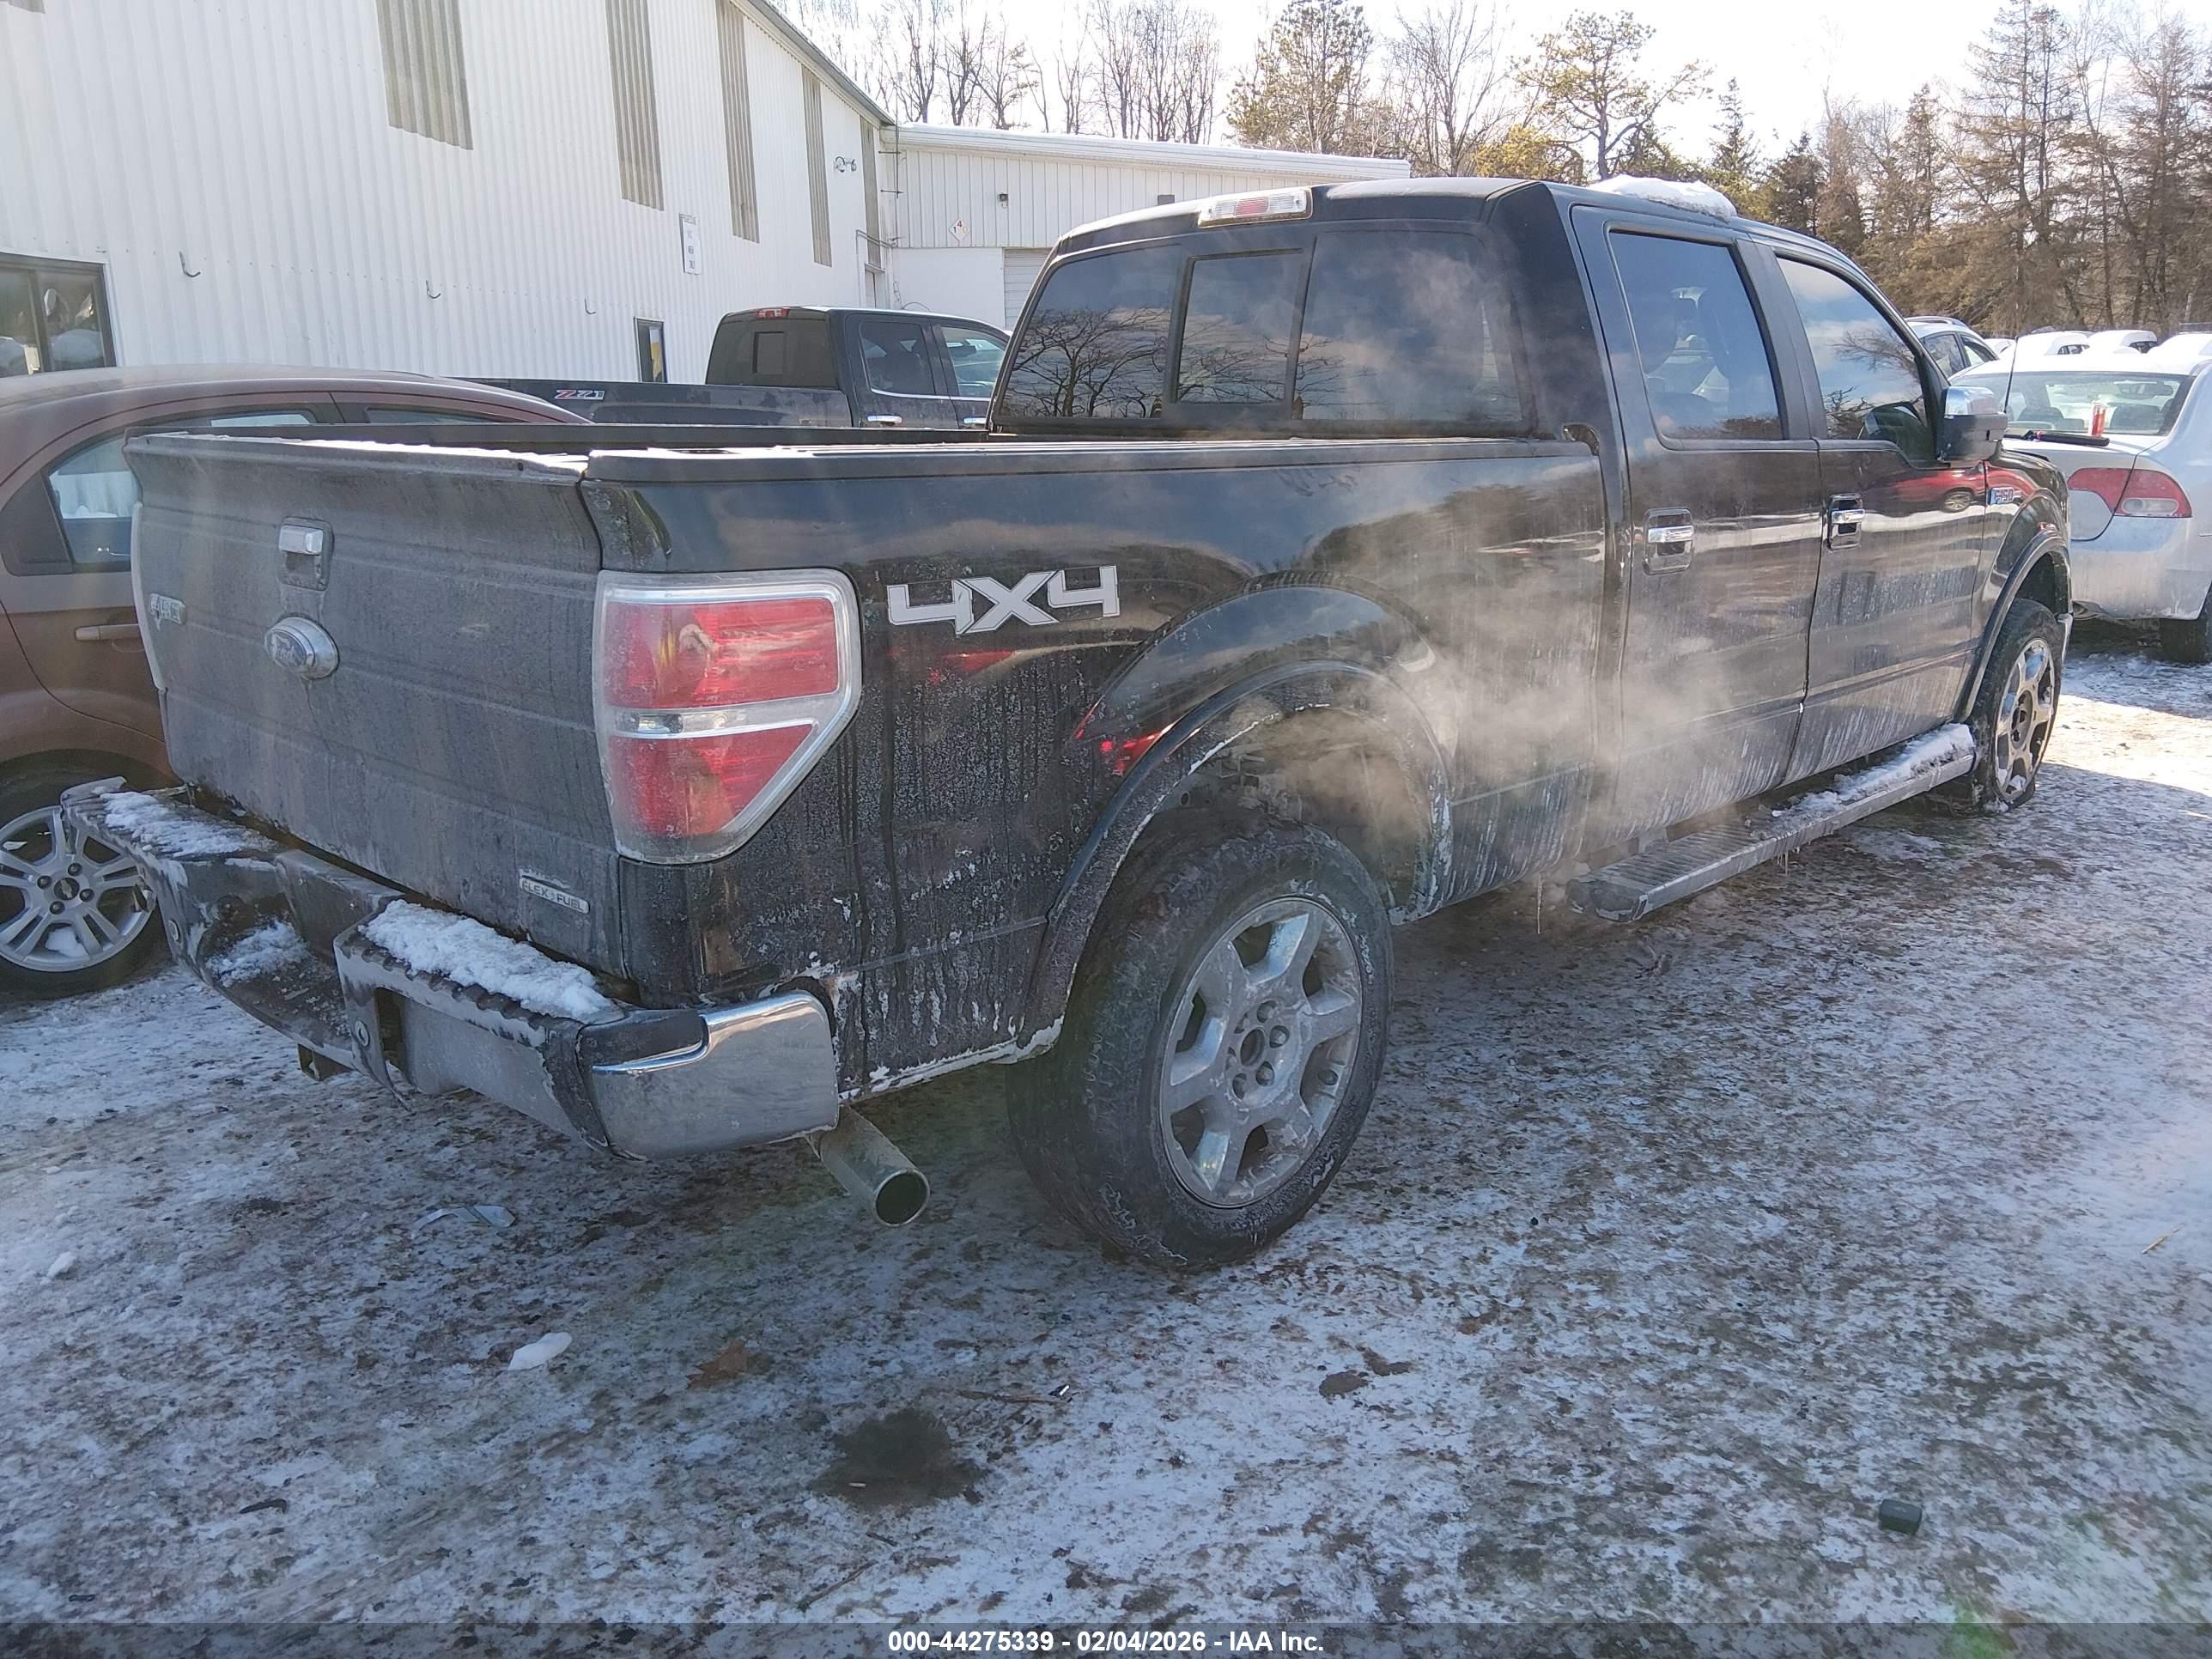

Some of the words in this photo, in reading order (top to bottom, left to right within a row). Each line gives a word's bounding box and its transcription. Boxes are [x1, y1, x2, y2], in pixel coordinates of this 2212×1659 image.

[554, 390, 605, 400] Z71
[886, 565, 1120, 635] 4X4
[522, 880, 549, 897] FLEX
[556, 893, 584, 910] FUEL
